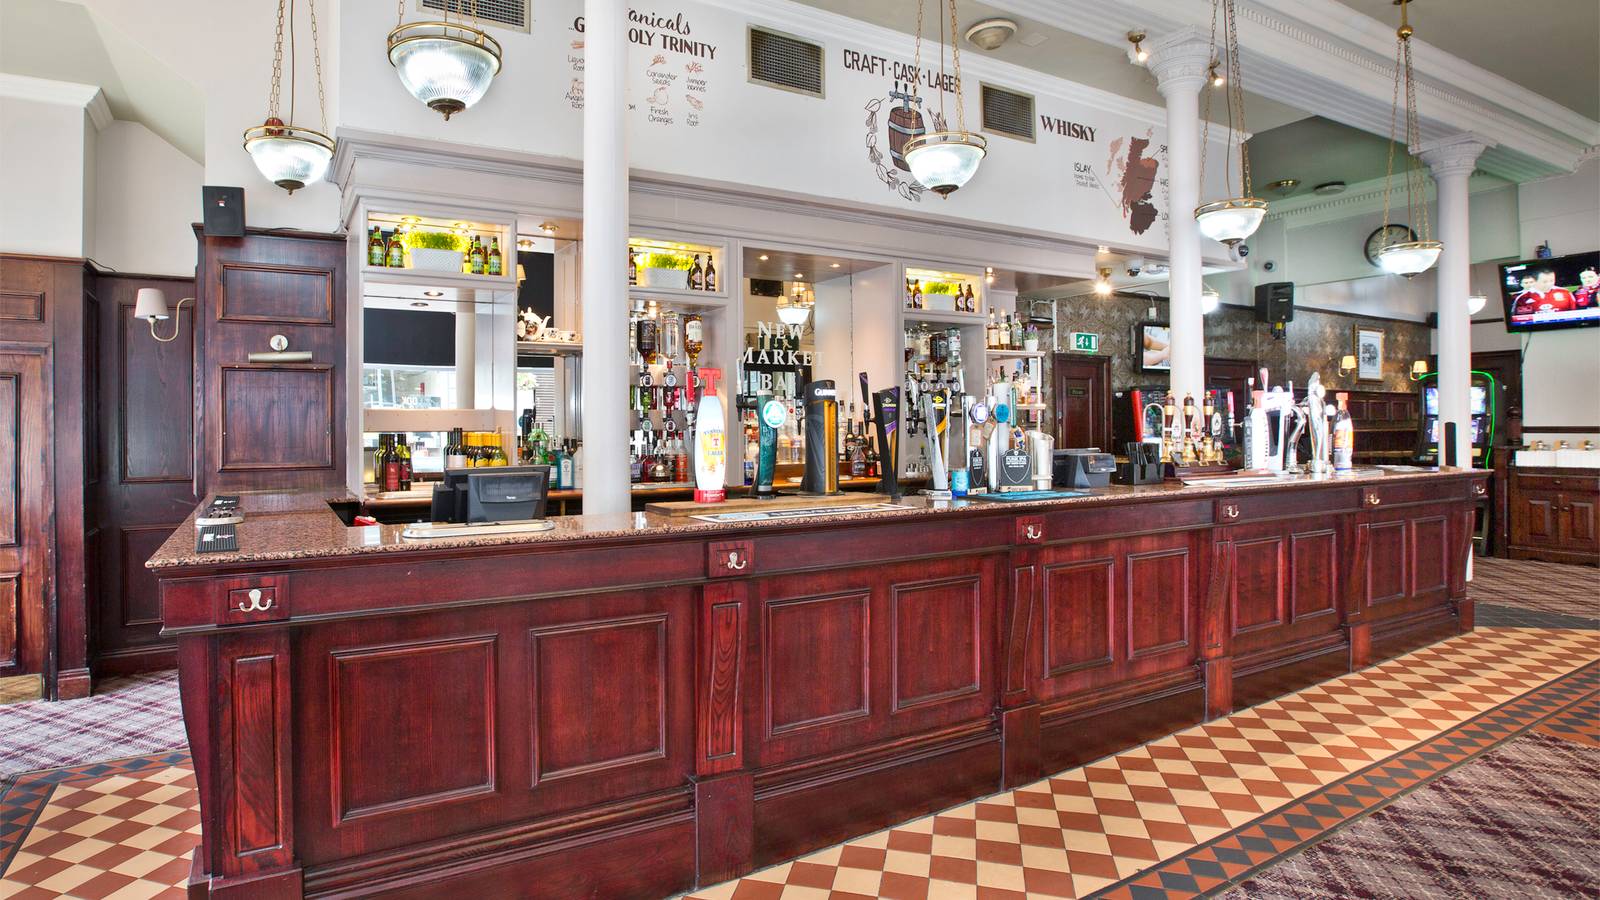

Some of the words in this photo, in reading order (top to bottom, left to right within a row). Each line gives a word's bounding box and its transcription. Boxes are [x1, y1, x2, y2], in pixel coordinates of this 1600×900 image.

[628, 9, 691, 36] anicals
[628, 27, 655, 47] OLY
[660, 33, 717, 60] TRINITY
[843, 48, 887, 77] CRAFT
[893, 61, 922, 86] CASK
[648, 114, 674, 126] Oranges
[650, 106, 669, 117] Fresh
[1040, 115, 1097, 142] WHISKY
[1073, 162, 1092, 174] ISLAY
[757, 321, 805, 340] NEW
[743, 346, 825, 366] MARKET
